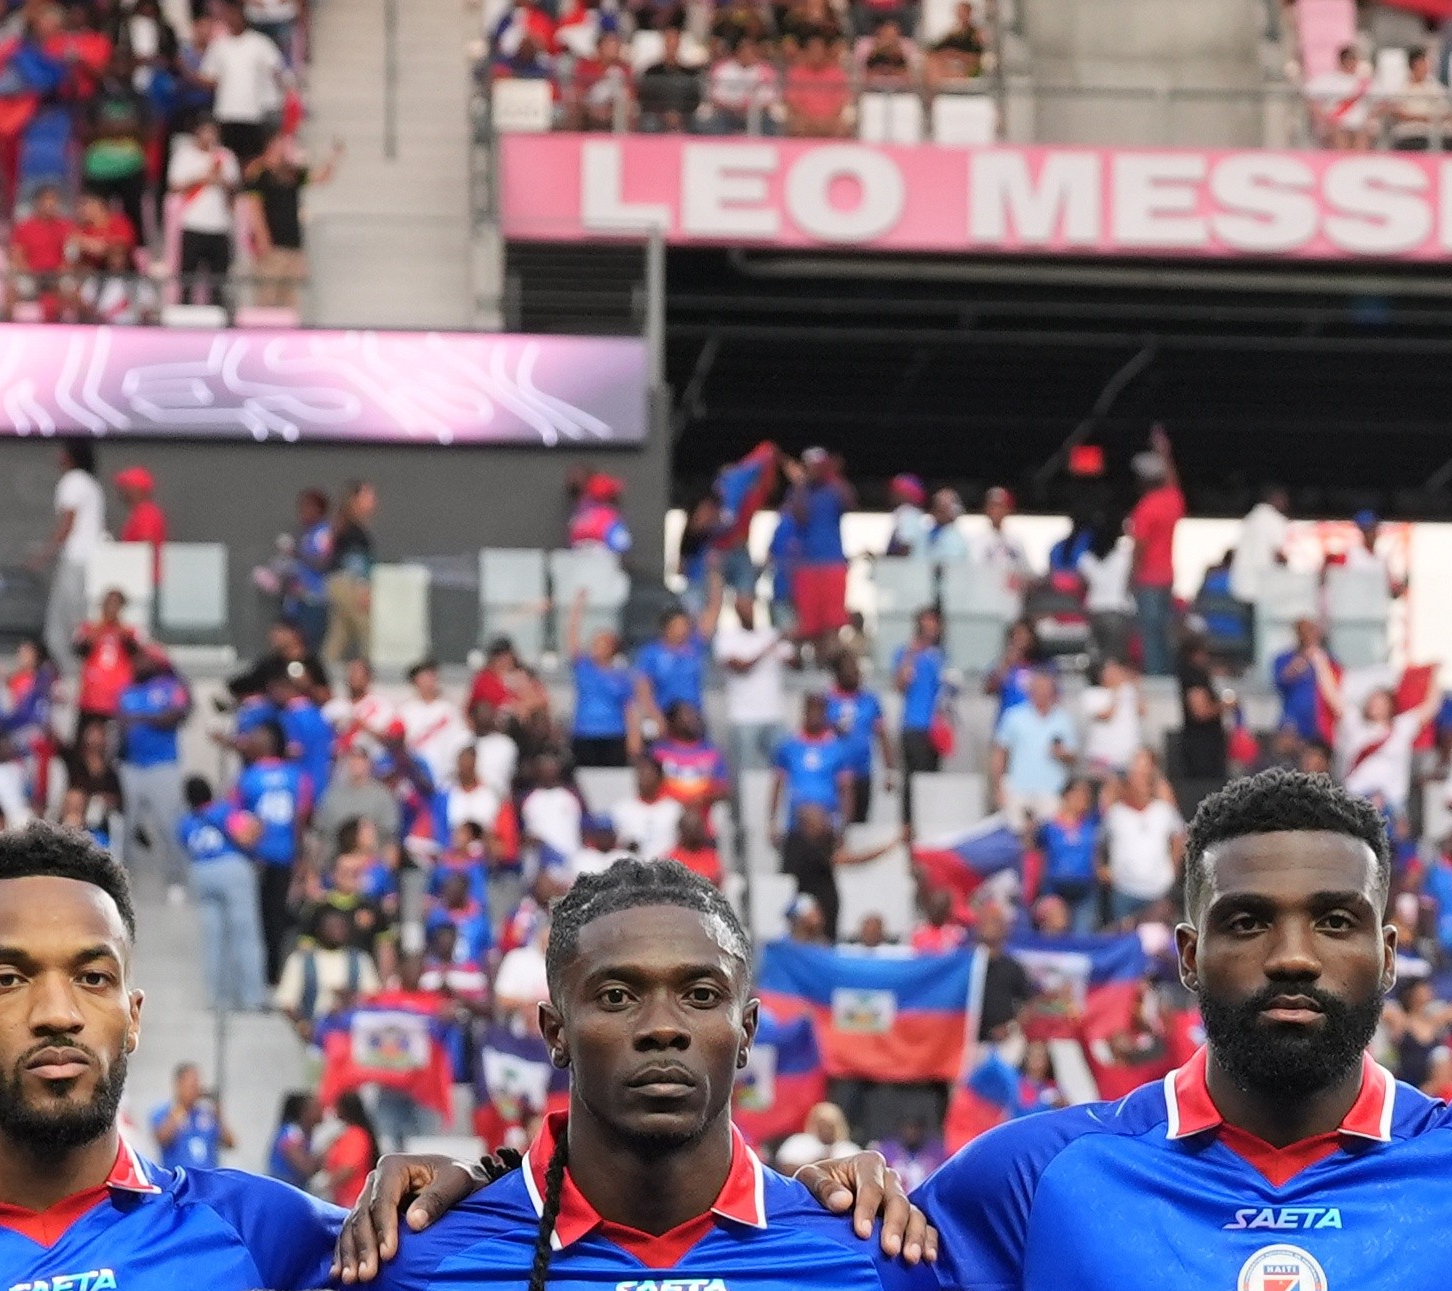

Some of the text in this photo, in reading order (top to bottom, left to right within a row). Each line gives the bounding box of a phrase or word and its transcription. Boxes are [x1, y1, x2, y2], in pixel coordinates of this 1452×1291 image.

[581, 139, 905, 241] LEO
[1222, 1208, 1343, 1229] SAETA
[1265, 1264, 1297, 1274] HAITI
